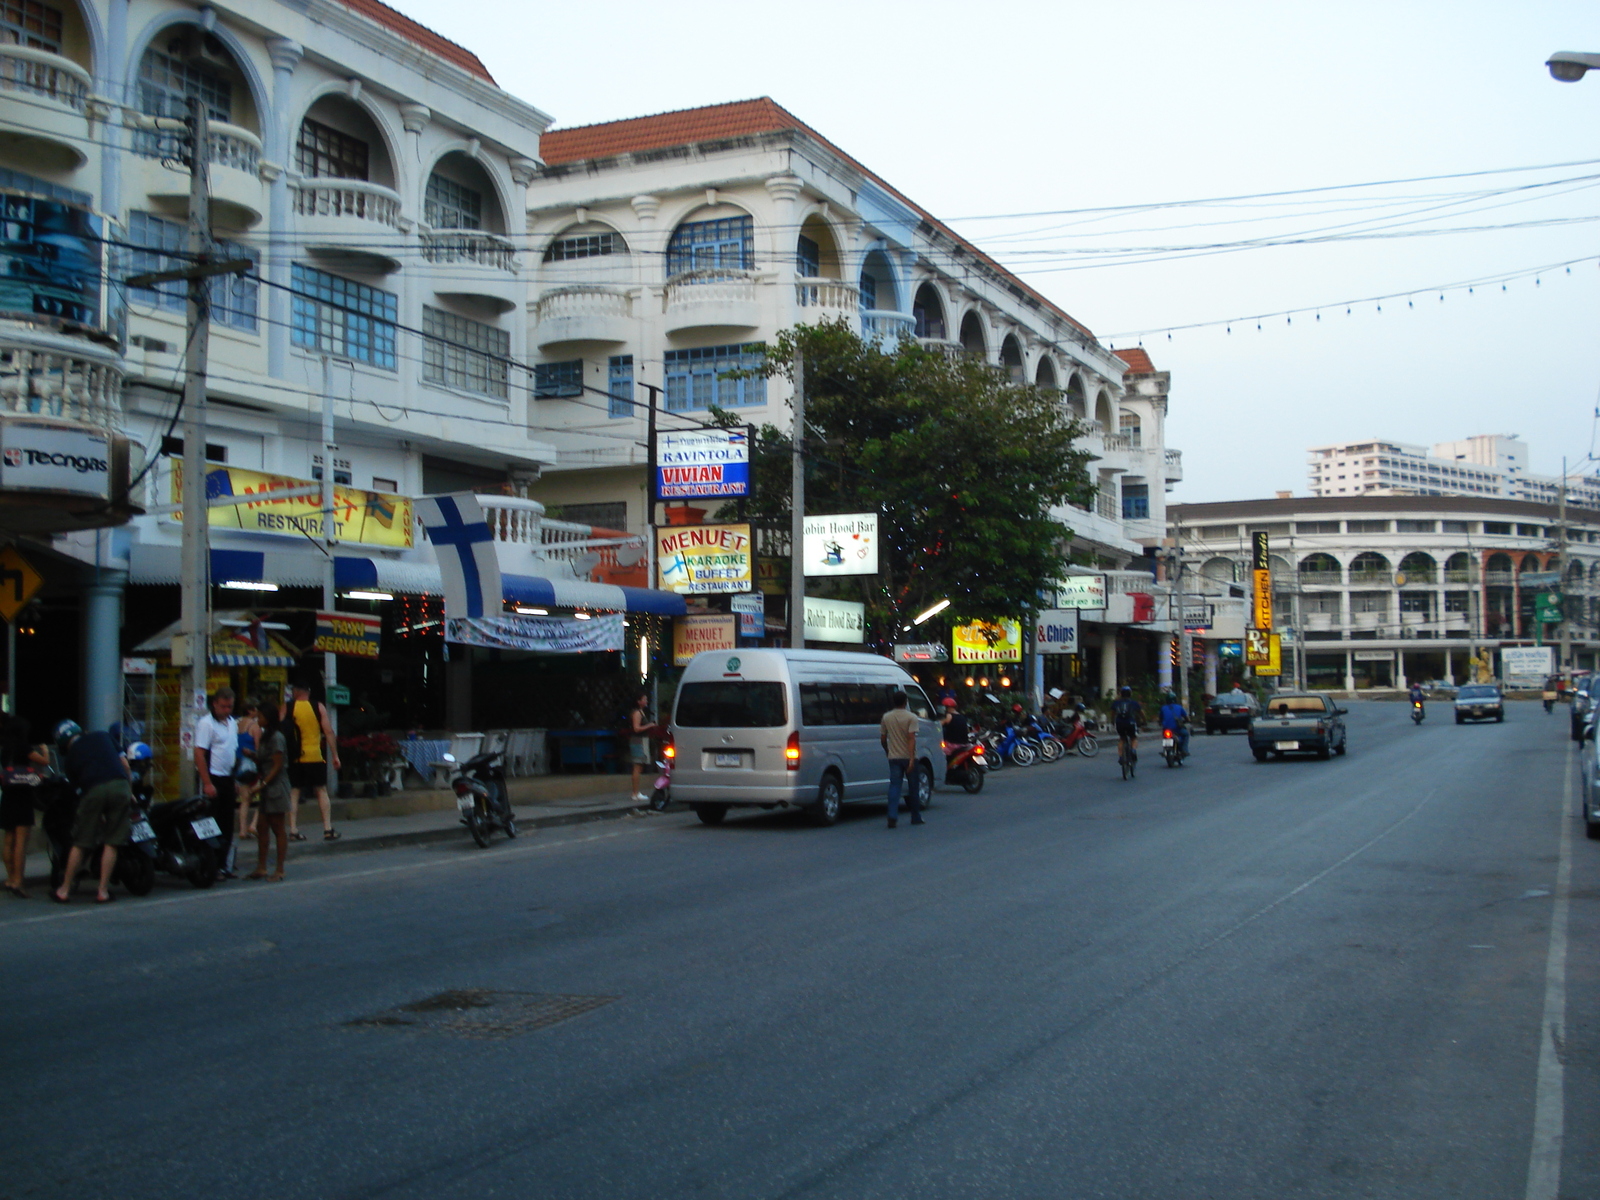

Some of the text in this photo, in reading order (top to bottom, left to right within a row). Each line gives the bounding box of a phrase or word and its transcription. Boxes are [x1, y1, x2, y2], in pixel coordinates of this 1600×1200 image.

[662, 466, 723, 484] VIVIAN
[661, 482, 746, 496] RESTAURANT
[402, 497, 412, 547] SAUNA
[803, 520, 875, 535] obin Hood Bar
[660, 529, 748, 554] MENUET
[687, 554, 747, 566] KARAOKE
[695, 568, 741, 579] BUFFET
[688, 581, 750, 591] RESTAURANT
[1261, 571, 1270, 629] KITCHEN
[330, 618, 366, 637] TAXI
[807, 608, 857, 630] Robin Hood Bar
[686, 627, 723, 640] MENUET
[1037, 625, 1047, 643] &
[1047, 624, 1074, 644] Chips
[316, 635, 378, 656] SERVICE
[1247, 653, 1268, 661] BAR
